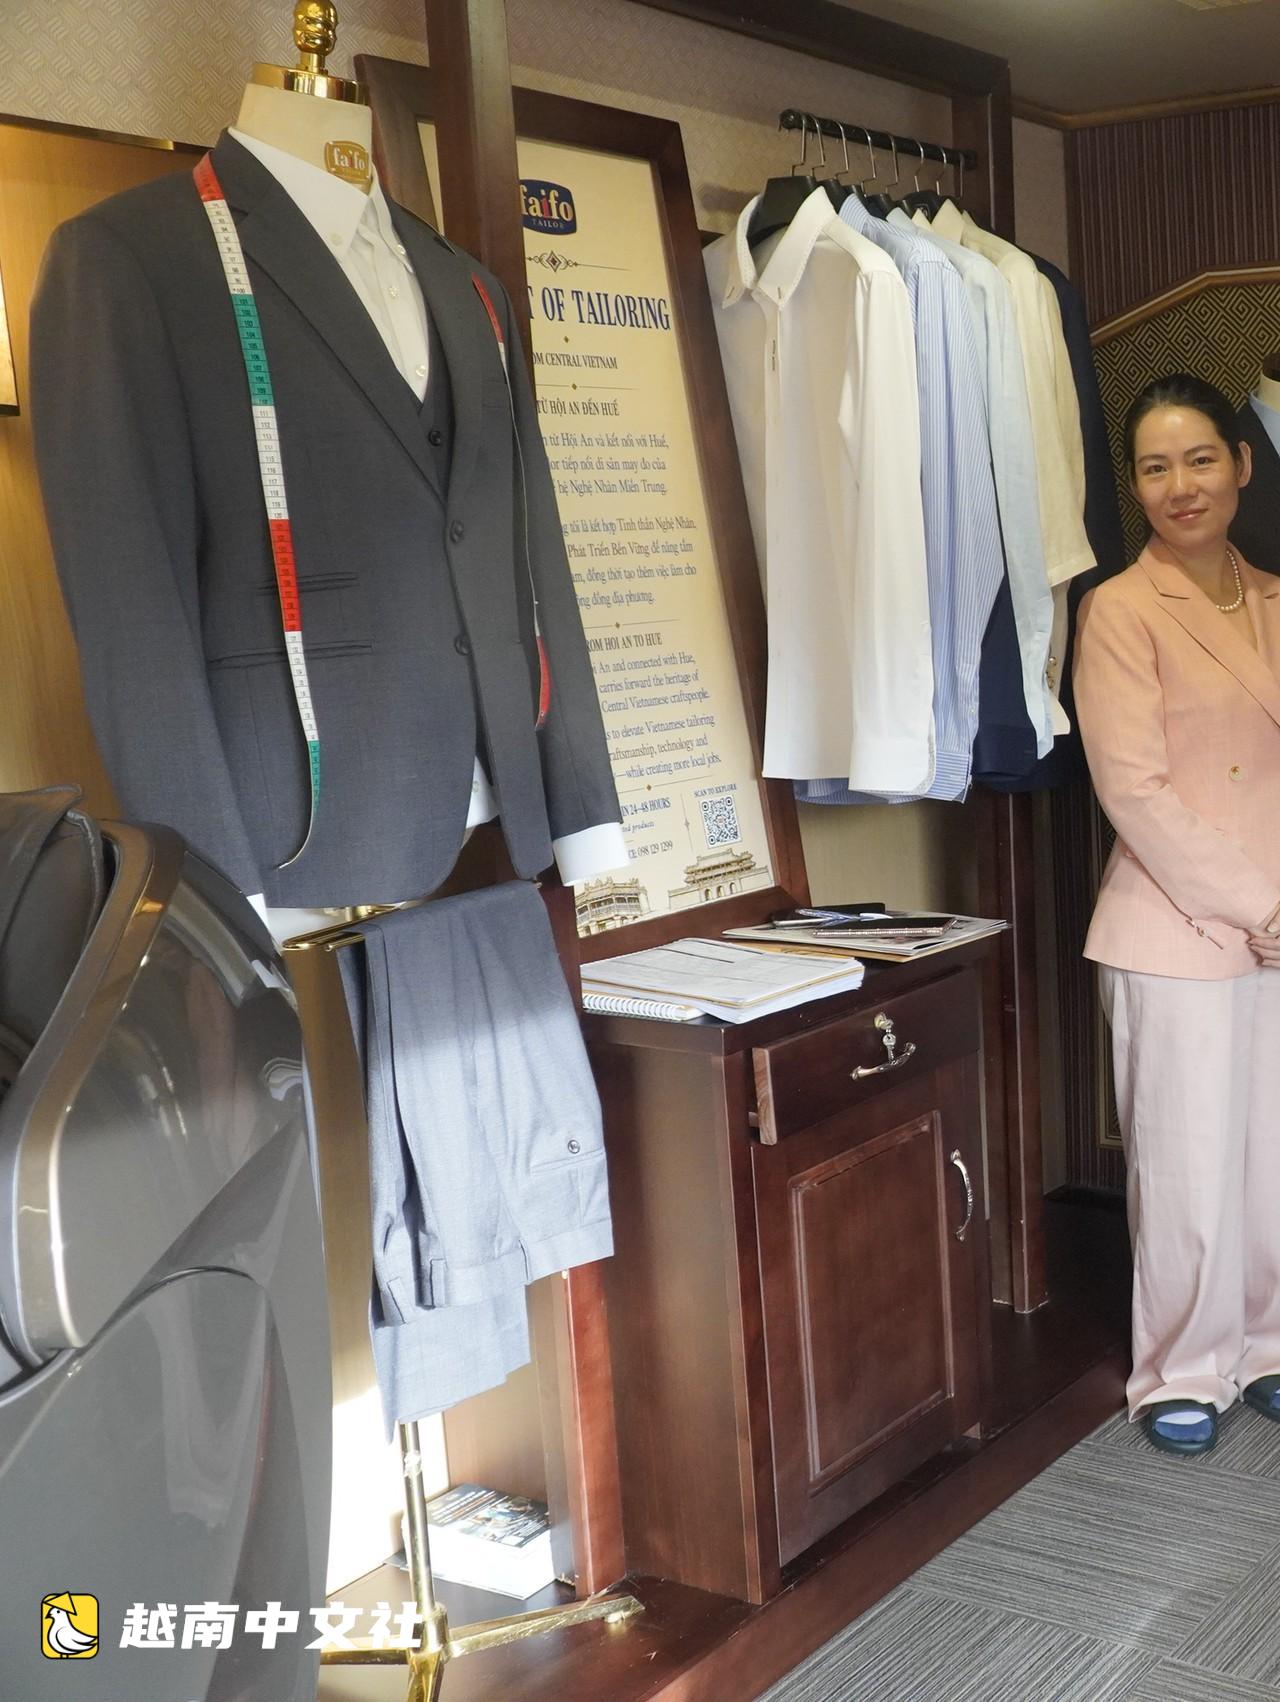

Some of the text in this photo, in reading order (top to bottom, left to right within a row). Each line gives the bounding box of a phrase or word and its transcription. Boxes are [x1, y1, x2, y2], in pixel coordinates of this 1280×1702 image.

[542, 287, 565, 321] OF
[572, 290, 671, 330] TAILORING
[546, 352, 582, 368] CENTRAL
[583, 355, 618, 369] VIETNAM
[550, 397, 566, 417] HỘI
[568, 401, 580, 415] AN
[582, 398, 600, 416] ĐẾN
[602, 398, 620, 416] HUẾ
[580, 433, 593, 447] An
[605, 637, 619, 651] HOI
[621, 636, 632, 649] AN
[633, 634, 644, 647] TO
[645, 633, 662, 647] HUE
[599, 662, 611, 674] An
[612, 658, 625, 672] and
[627, 655, 662, 670] connected
[662, 652, 678, 666] with
[598, 669, 699, 693] carries forward the heritage of
[601, 698, 629, 713] Central
[629, 696, 669, 709] Vietnamese
[611, 729, 620, 738] to
[621, 725, 644, 737] elevate
[645, 720, 686, 733] Vietnamese
[686, 714, 715, 727] tailoring
[657, 738, 694, 752] technology
[695, 733, 708, 747] and
[645, 761, 674, 775] creating
[673, 758, 690, 770] more
[690, 754, 706, 767] local
